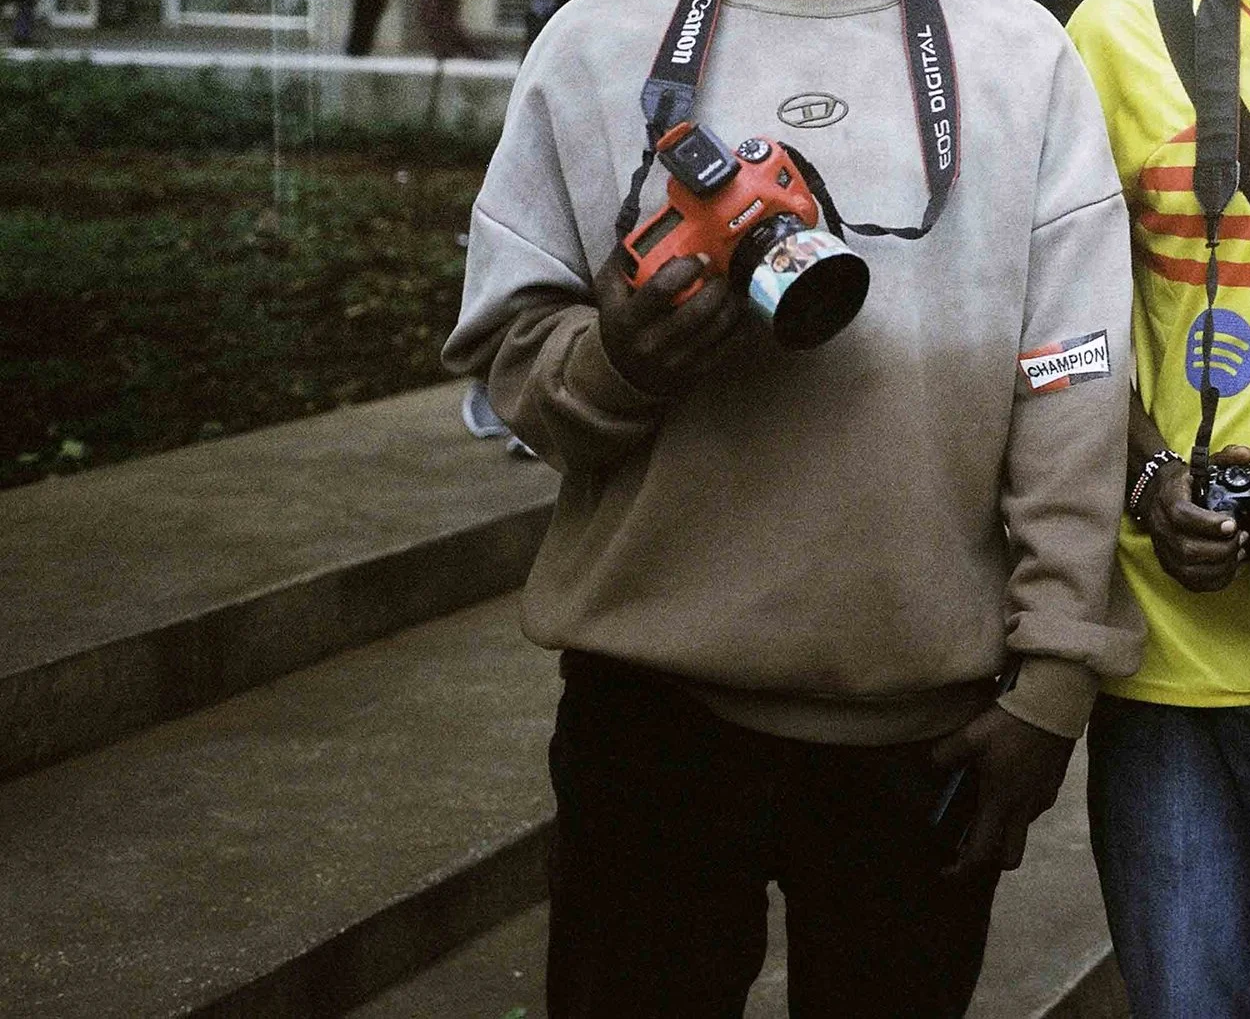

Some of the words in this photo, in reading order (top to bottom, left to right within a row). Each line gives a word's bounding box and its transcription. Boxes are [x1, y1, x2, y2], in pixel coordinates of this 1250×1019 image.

[917, 24, 946, 113] DIGITAL
[934, 119, 952, 170] EOS
[728, 198, 763, 230] Canon
[1026, 345, 1106, 378] CHAMPION
